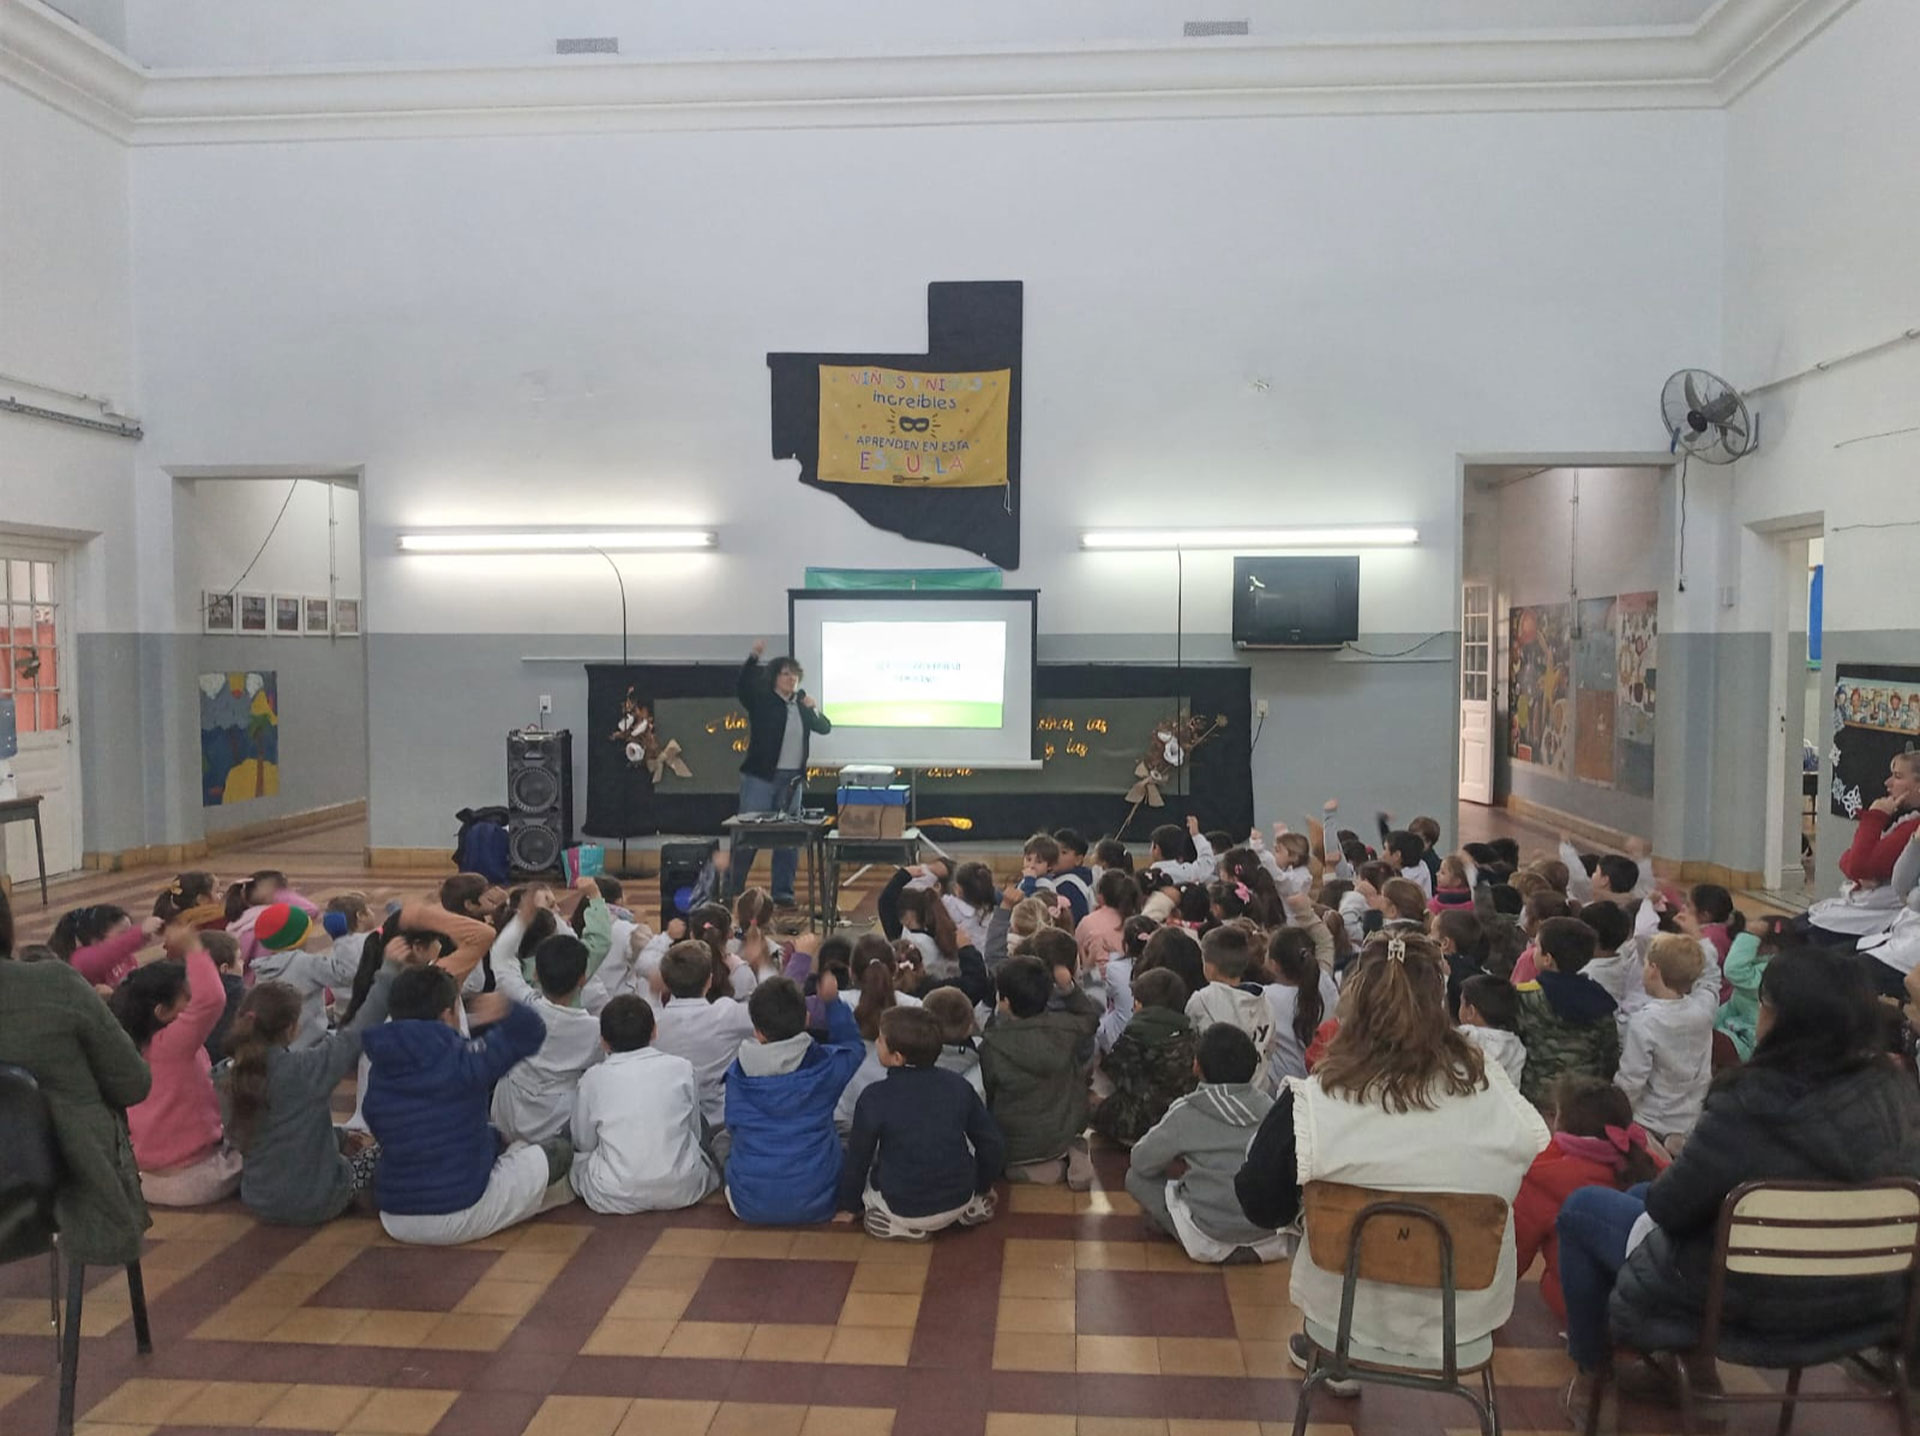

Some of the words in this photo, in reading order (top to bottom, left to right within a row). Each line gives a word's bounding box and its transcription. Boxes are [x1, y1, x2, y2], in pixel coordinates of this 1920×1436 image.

[850, 370, 906, 390] NIÑS
[925, 376, 983, 392] NIS
[857, 435, 919, 451] APRENDEN
[922, 440, 938, 452] EN
[941, 440, 970, 452] ESTA
[860, 450, 964, 475] ESCULA
